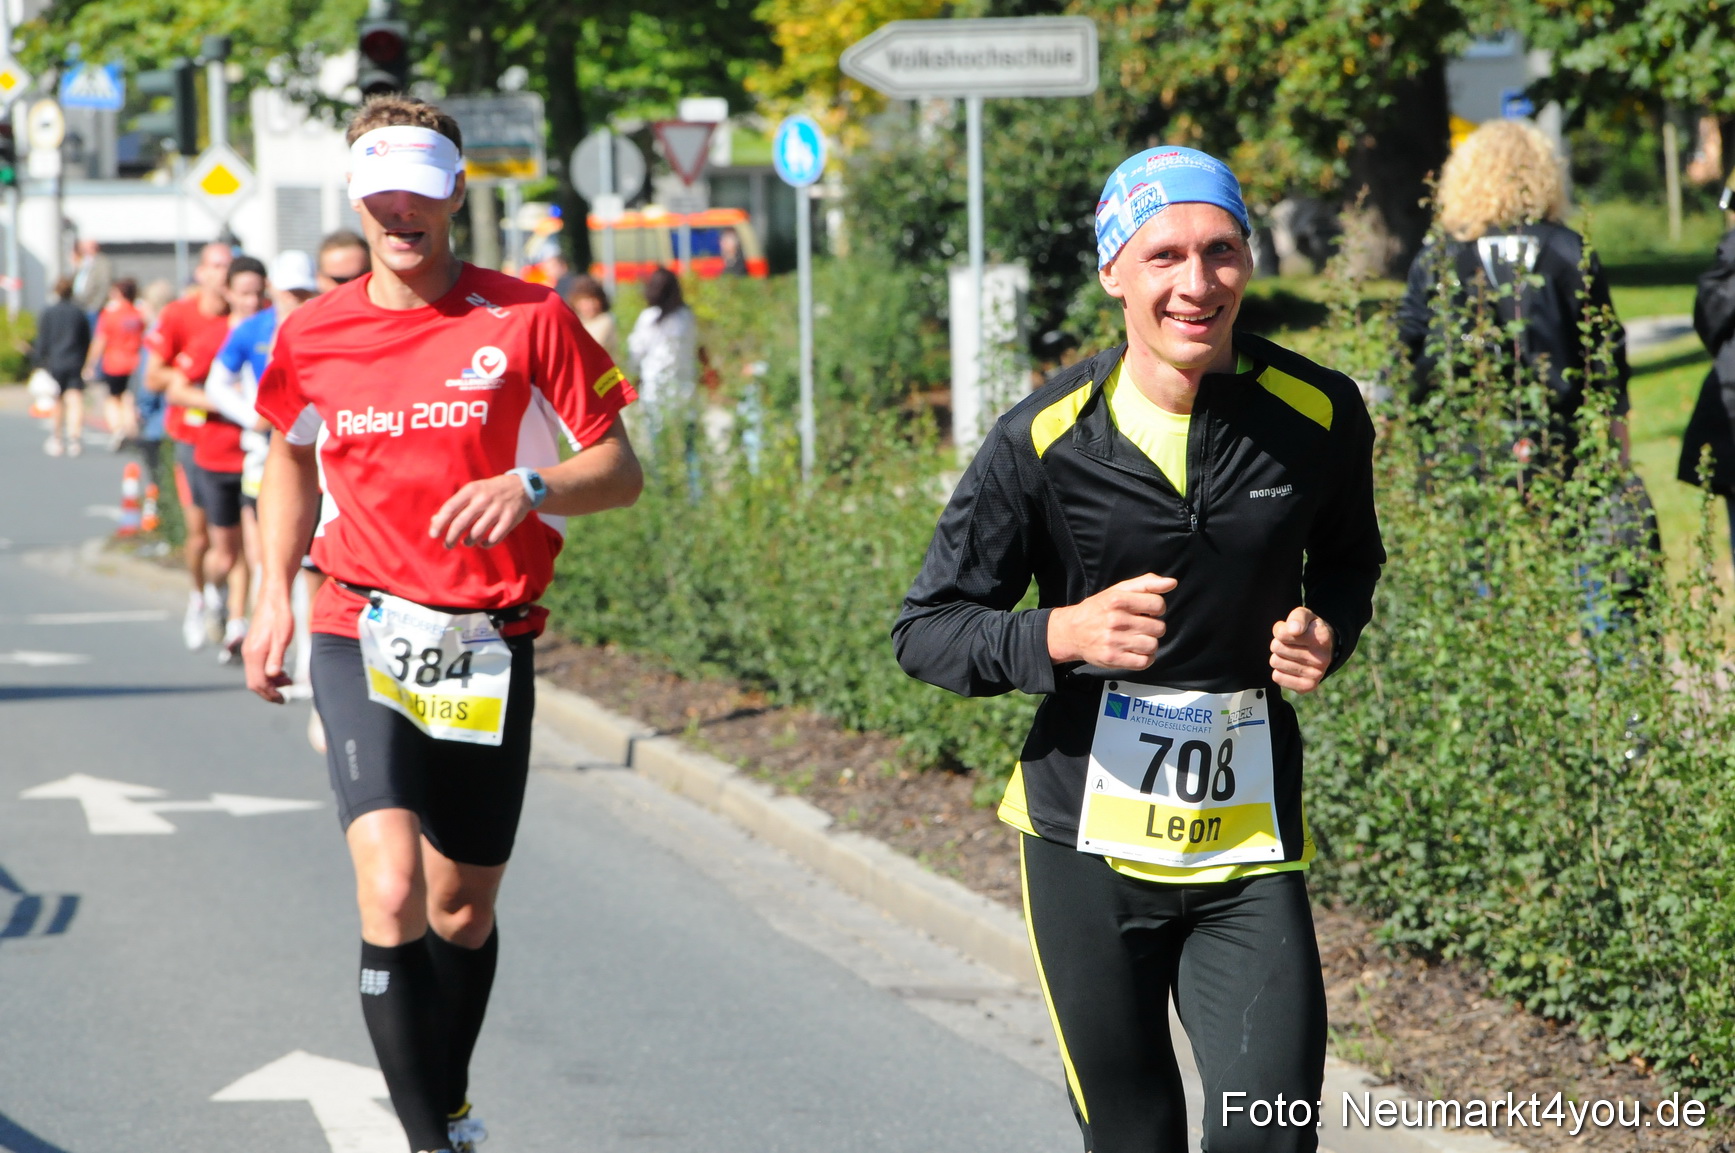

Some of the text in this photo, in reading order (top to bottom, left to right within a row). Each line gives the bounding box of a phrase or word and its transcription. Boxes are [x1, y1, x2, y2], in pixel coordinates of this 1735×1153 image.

[886, 46, 1074, 70] Volkshochschule
[336, 400, 489, 438] Relay 2009
[1249, 483, 1293, 499] manguun
[387, 637, 475, 689] 384
[1129, 715, 1212, 734] AKTIENGESELLSCHAFT
[1132, 697, 1213, 725] PFLEIDERER
[1138, 732, 1236, 804] 708
[1096, 778, 1104, 790] A
[1145, 804, 1222, 845] Leon
